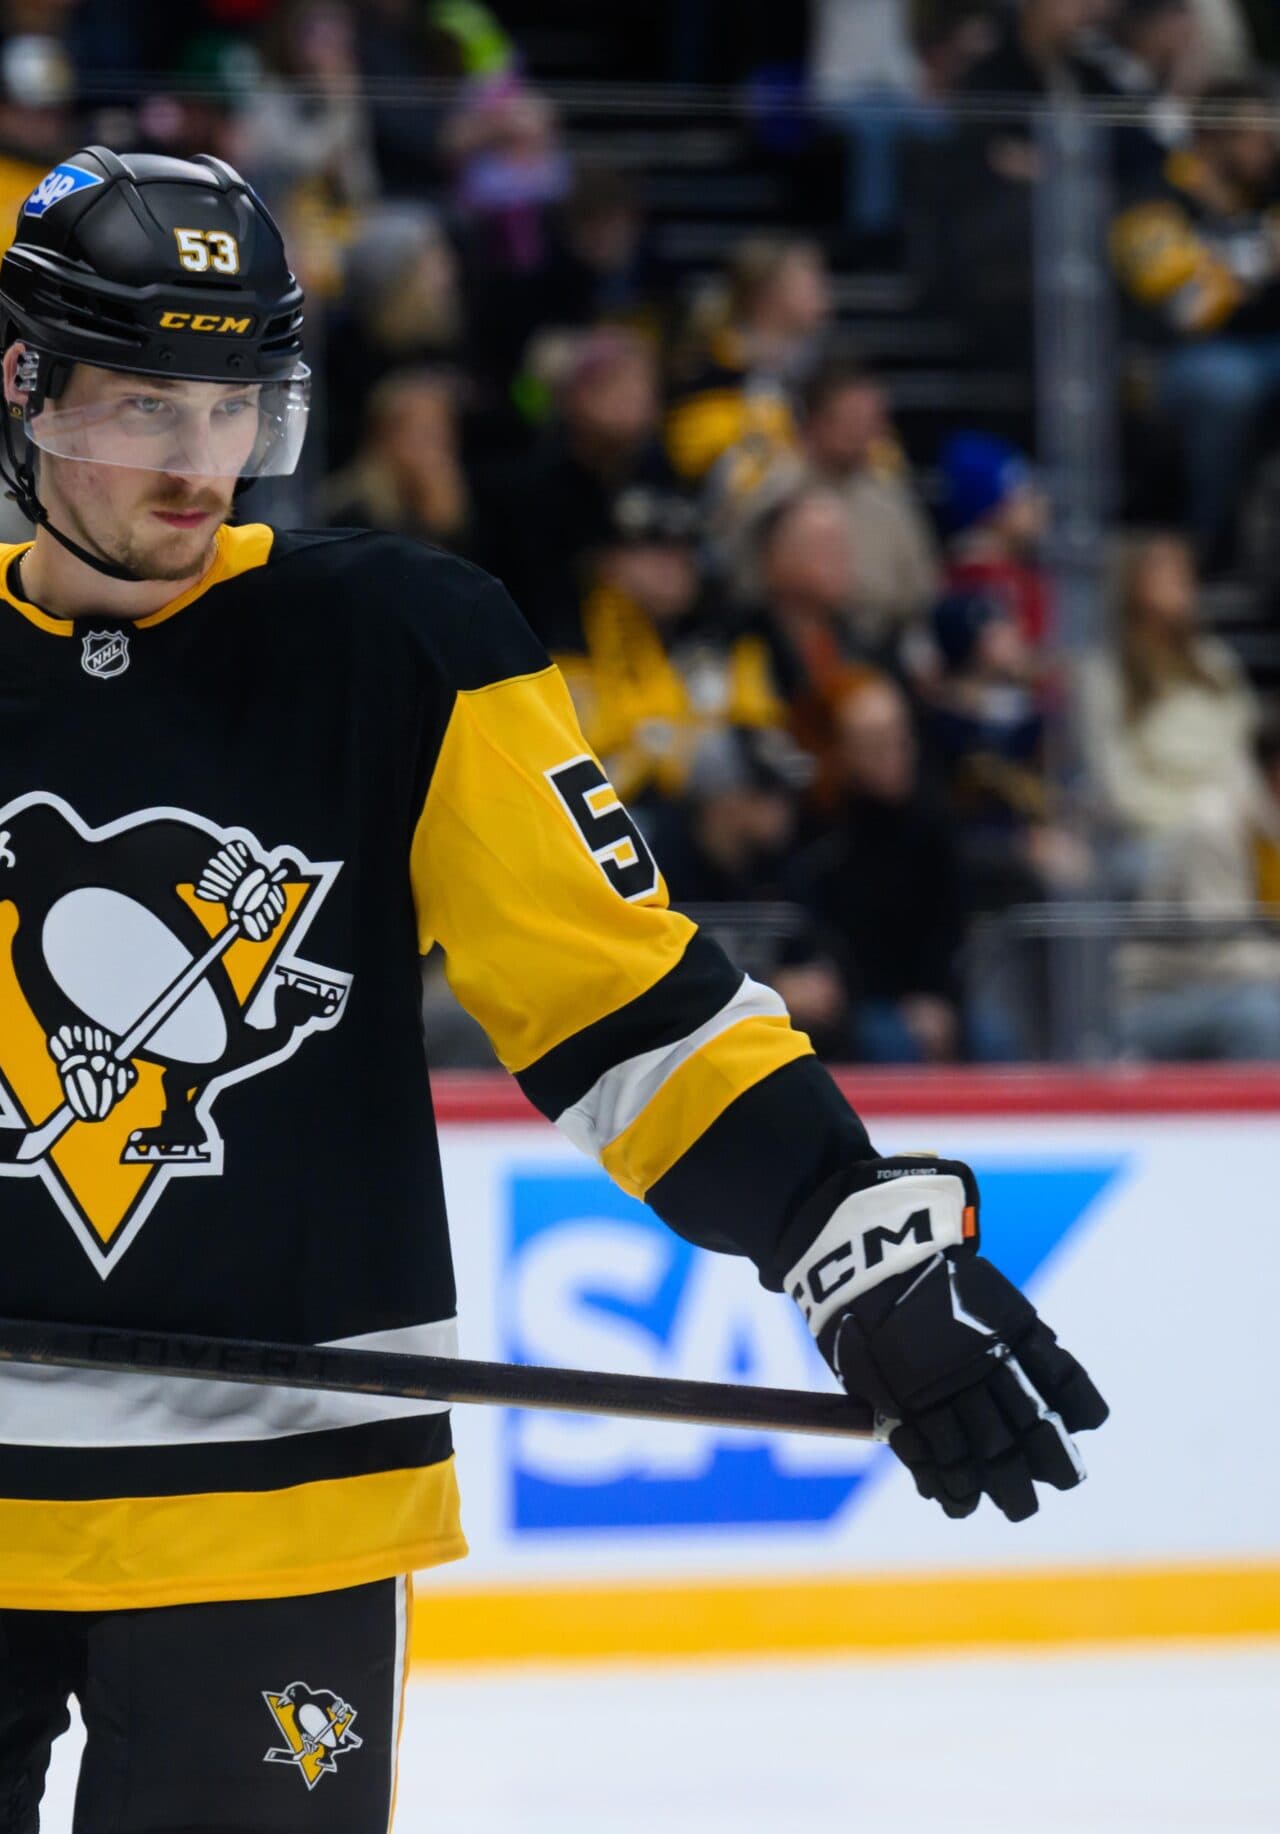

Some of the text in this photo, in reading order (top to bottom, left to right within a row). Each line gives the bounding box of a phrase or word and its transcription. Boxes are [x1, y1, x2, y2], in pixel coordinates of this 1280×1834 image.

[28, 172, 76, 206] SAP
[174, 227, 240, 275] 53
[159, 311, 252, 334] CCM
[92, 643, 121, 669] NHL
[877, 1168, 937, 1180] TOMASINO
[520, 1218, 886, 1487] SA
